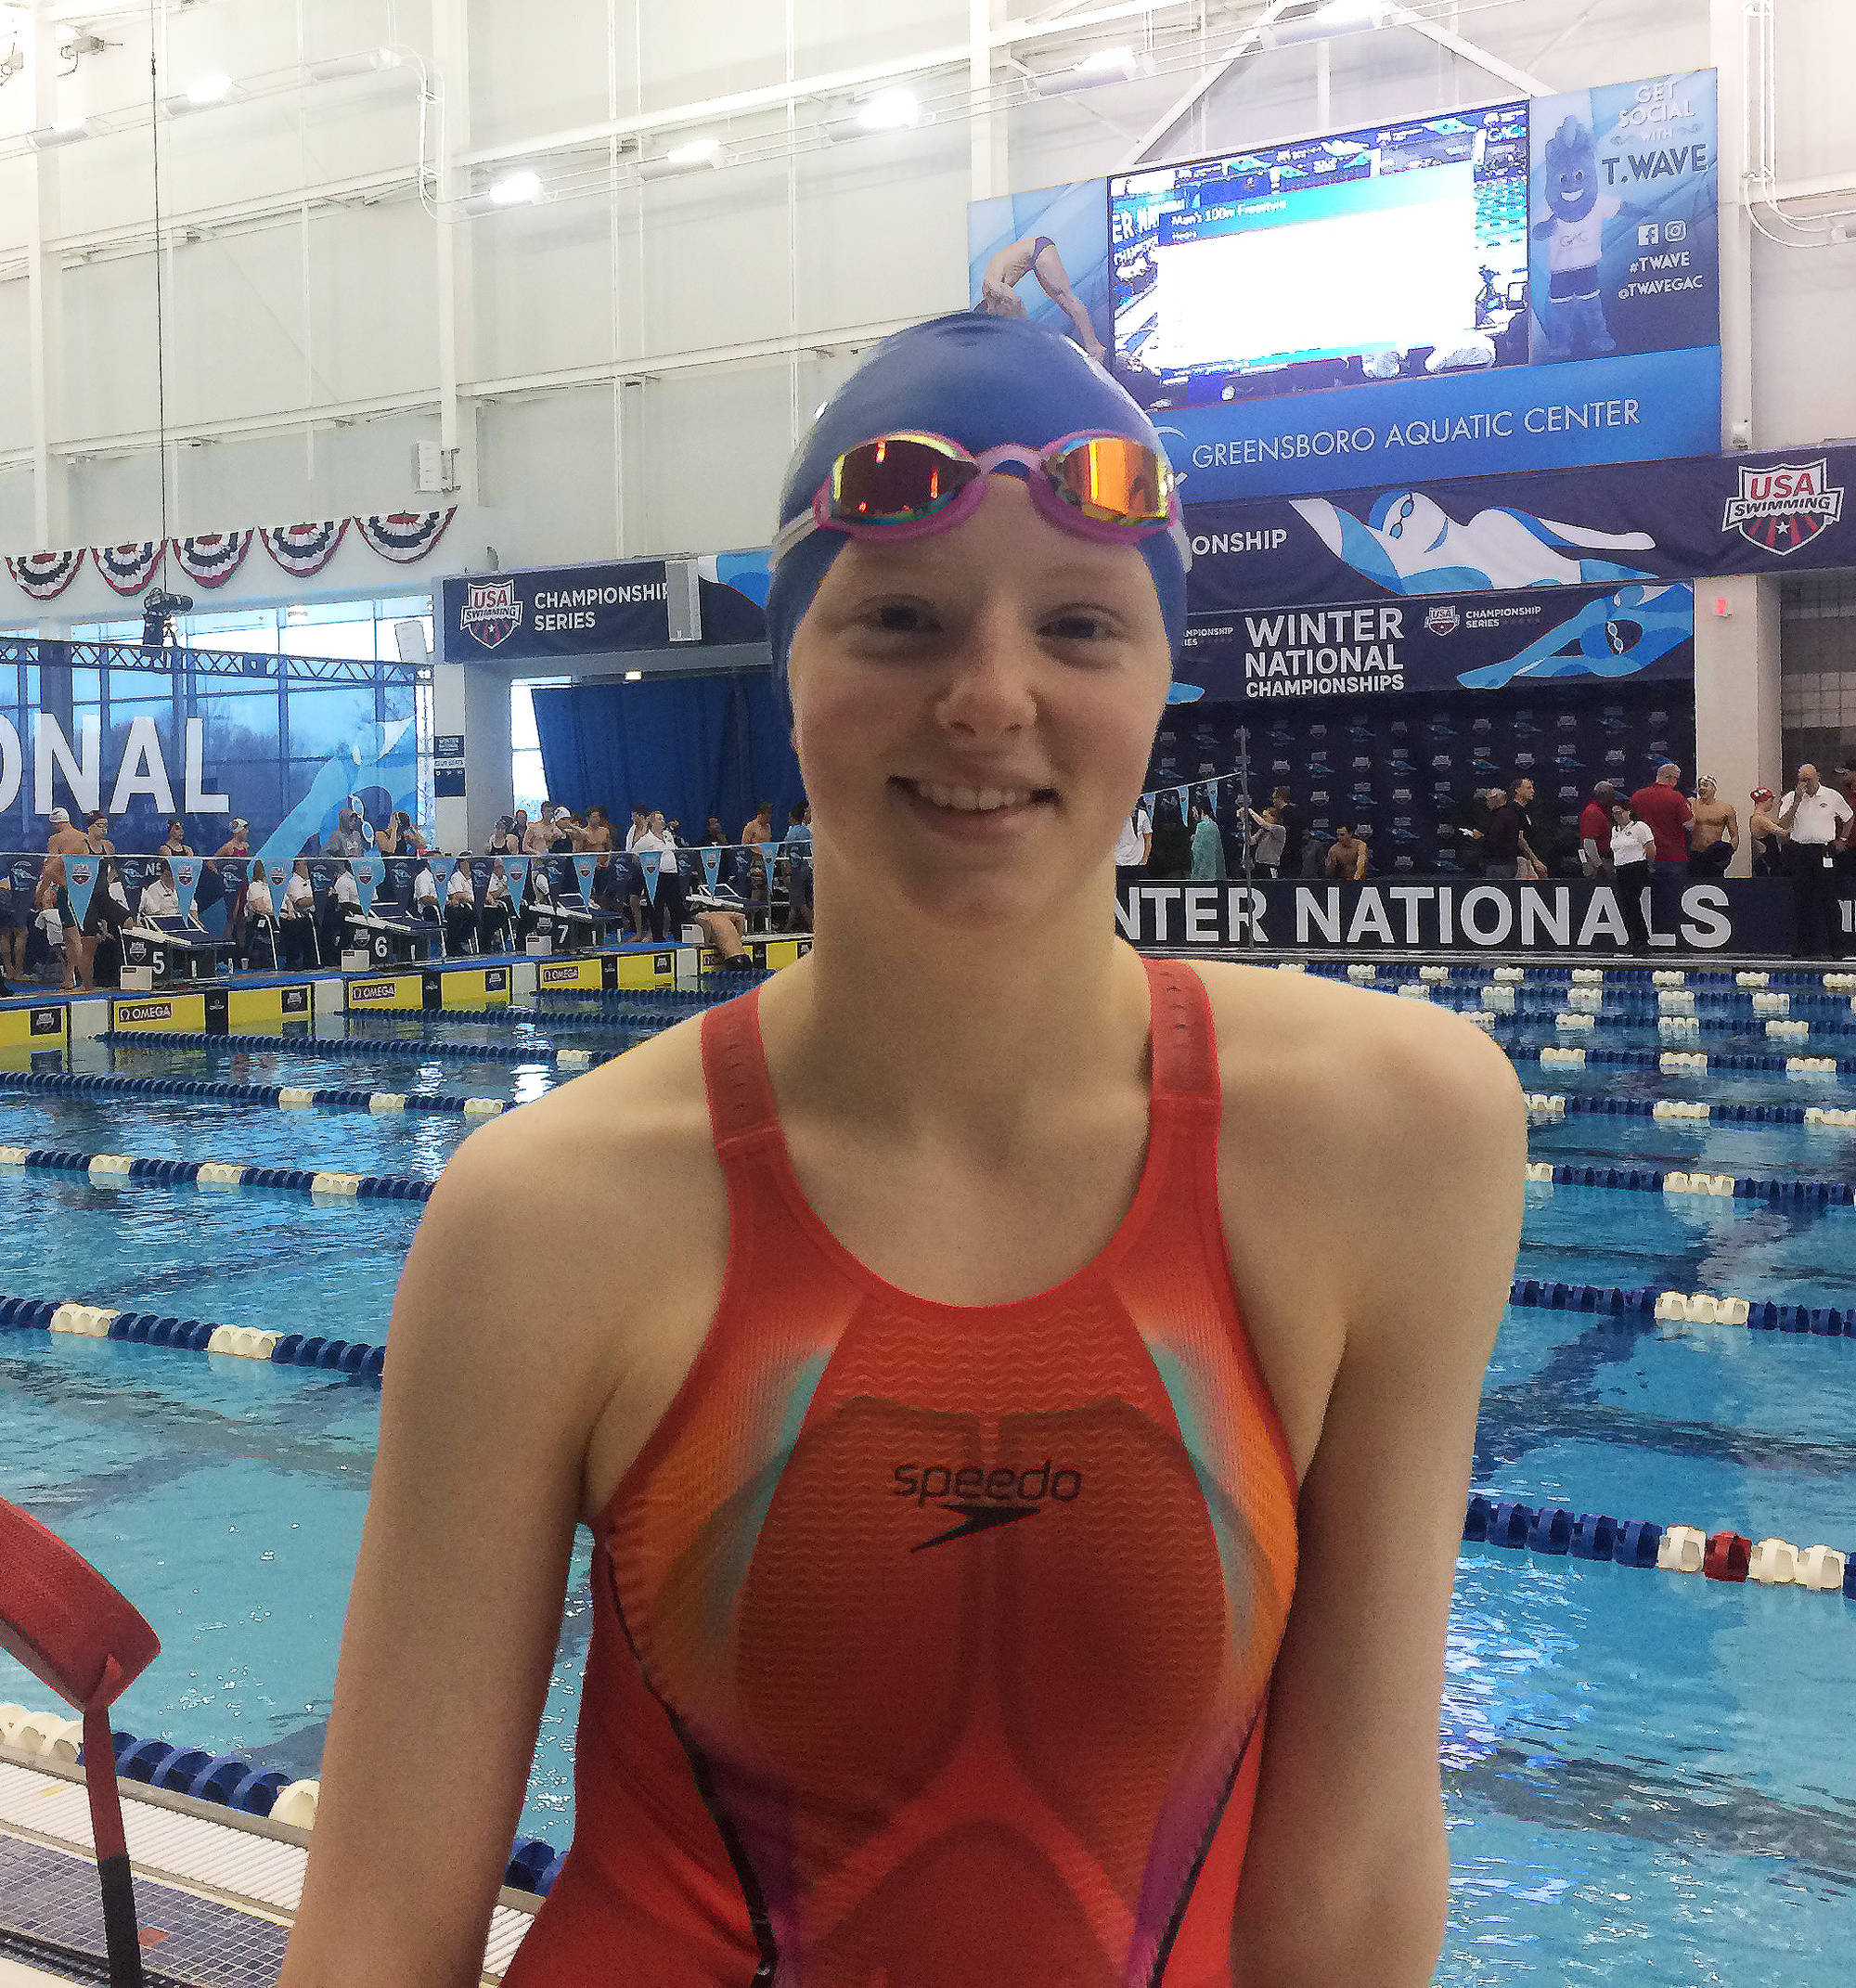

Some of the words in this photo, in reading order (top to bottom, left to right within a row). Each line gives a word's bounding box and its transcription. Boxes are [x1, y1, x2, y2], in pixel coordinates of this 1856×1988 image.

[1636, 78, 1678, 104] GET
[1618, 101, 1696, 129] SOCIAL
[1602, 144, 1708, 186] T.WAVE
[1629, 251, 1691, 274] #TWAVE
[1618, 275, 1704, 300] @TWAVEGAC
[1192, 426, 1375, 470] GREENSBORO
[1385, 410, 1514, 448] AQUATIC
[1524, 398, 1642, 434] CENTER
[1750, 472, 1815, 500] USA
[1734, 496, 1831, 517] SWIMMING
[1192, 528, 1288, 556] ONSHIP
[474, 590, 508, 610] USA
[535, 611, 597, 632] SERIES
[1465, 605, 1542, 620] CHAMPIONSHIP
[1465, 618, 1500, 629] SERIES
[1244, 607, 1405, 649] WINTER
[1244, 643, 1404, 678] NATIONAL
[1245, 674, 1405, 698] CHAMPIONSHIPS
[1295, 884, 1732, 949] NATIONALS
[558, 924, 569, 944] 7
[374, 936, 388, 958] 6
[152, 951, 165, 975] 5
[364, 983, 395, 999] OMEGA
[132, 1003, 171, 1021] OMEGA
[894, 1458, 1082, 1508] speedo
